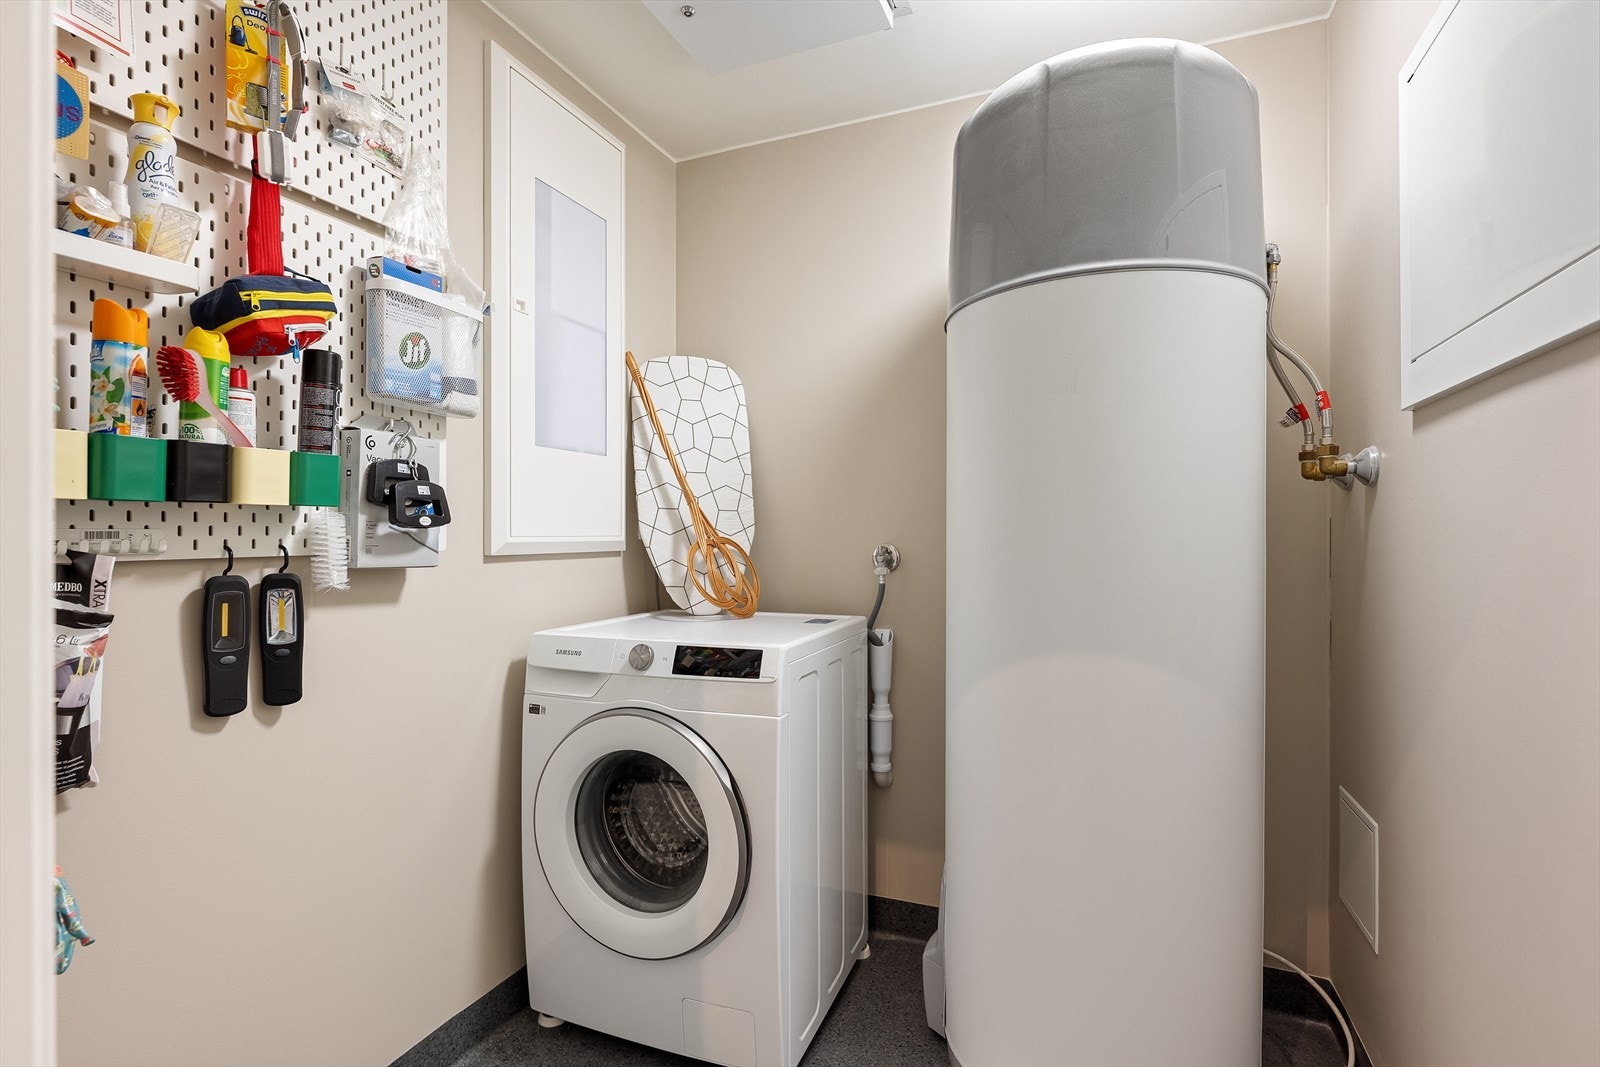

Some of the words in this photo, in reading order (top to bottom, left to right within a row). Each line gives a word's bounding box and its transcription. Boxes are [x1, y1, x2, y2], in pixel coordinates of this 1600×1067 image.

[243, 8, 268, 21] swir
[92, 578, 107, 608] XTRA
[555, 648, 582, 656] SAMSUNG
